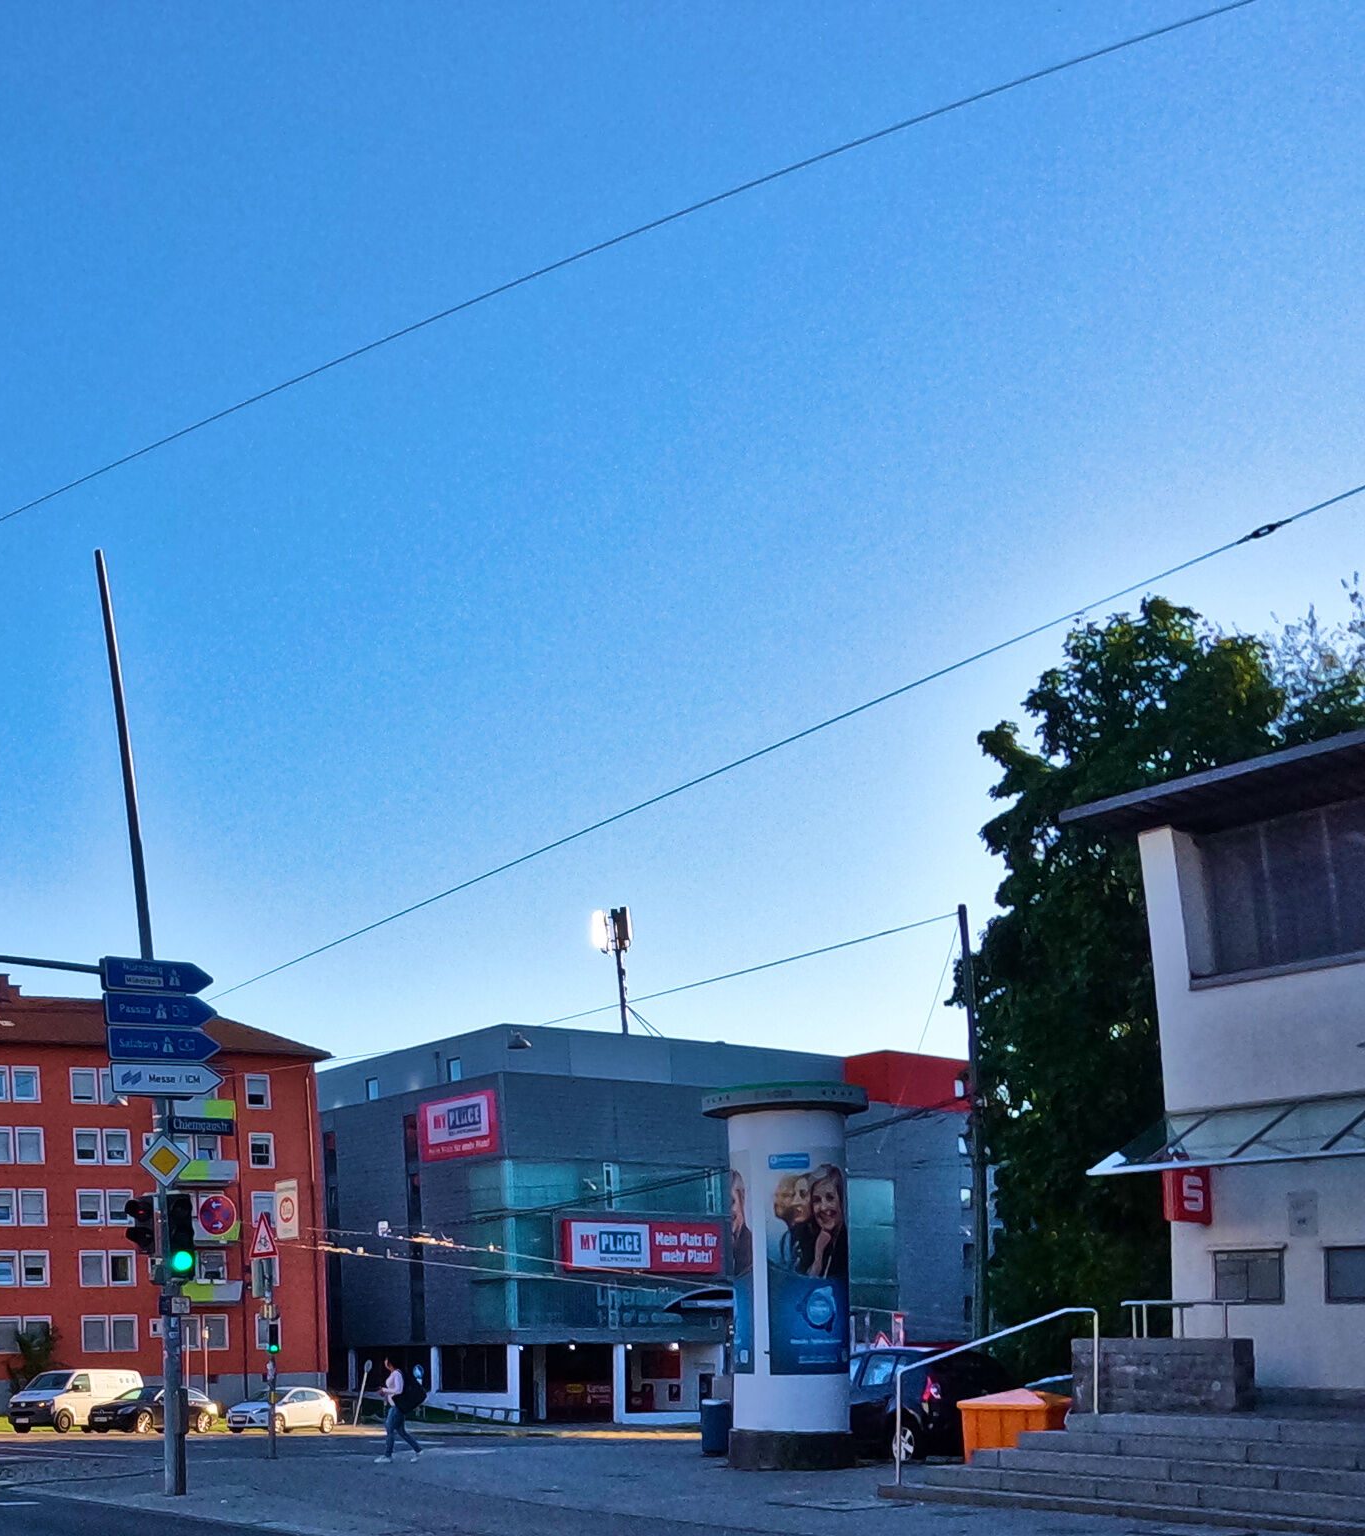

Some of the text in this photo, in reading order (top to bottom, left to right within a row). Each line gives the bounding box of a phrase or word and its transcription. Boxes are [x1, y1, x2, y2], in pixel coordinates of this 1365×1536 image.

[148, 1074, 176, 1084] Messe
[448, 1105, 481, 1127] PLACE
[580, 1233, 641, 1252] MY PLACE
[655, 1232, 678, 1246] Mein
[680, 1232, 702, 1247] Platz
